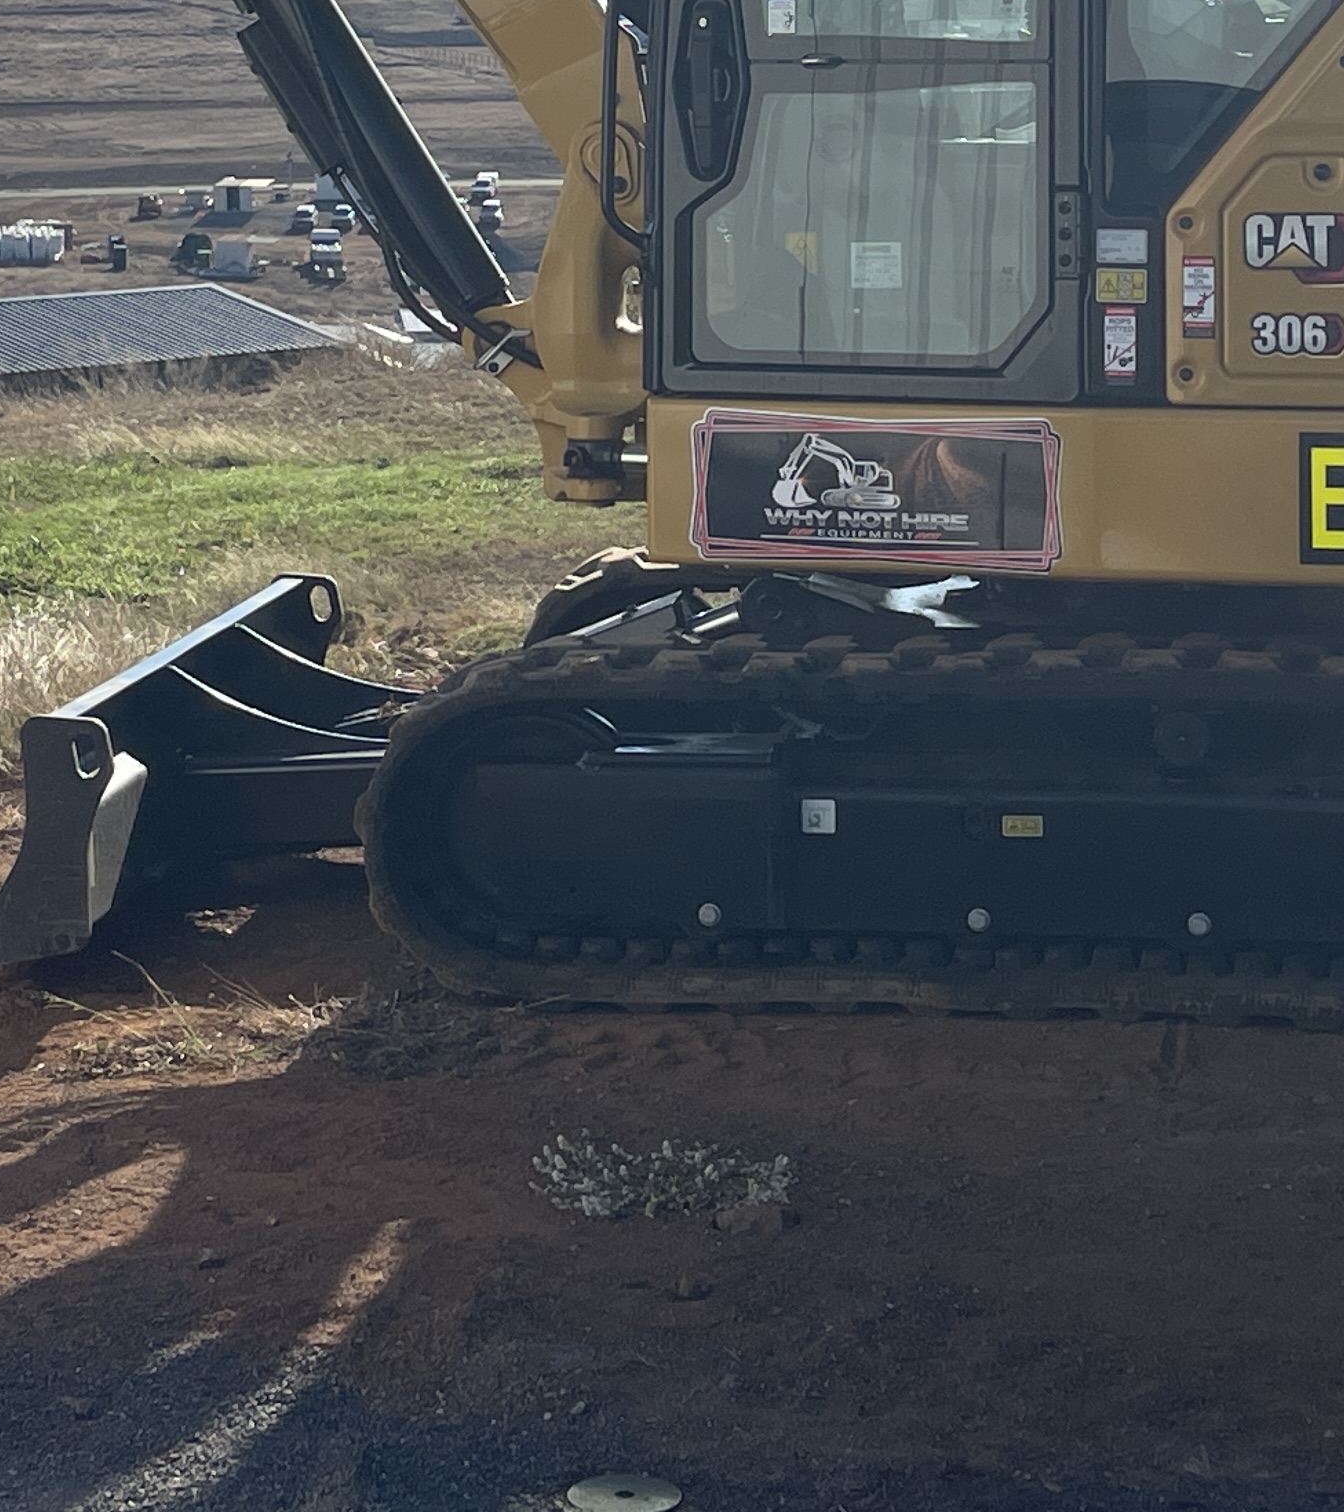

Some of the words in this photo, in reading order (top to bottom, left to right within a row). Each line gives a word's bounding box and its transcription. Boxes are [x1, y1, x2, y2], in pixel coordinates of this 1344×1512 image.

[1245, 214, 1336, 269] CAT
[1252, 314, 1327, 355] 306
[764, 508, 832, 526] WHY
[838, 511, 898, 530] NOT
[902, 513, 969, 532] HIRE
[817, 529, 914, 540] EQUIPMENT
